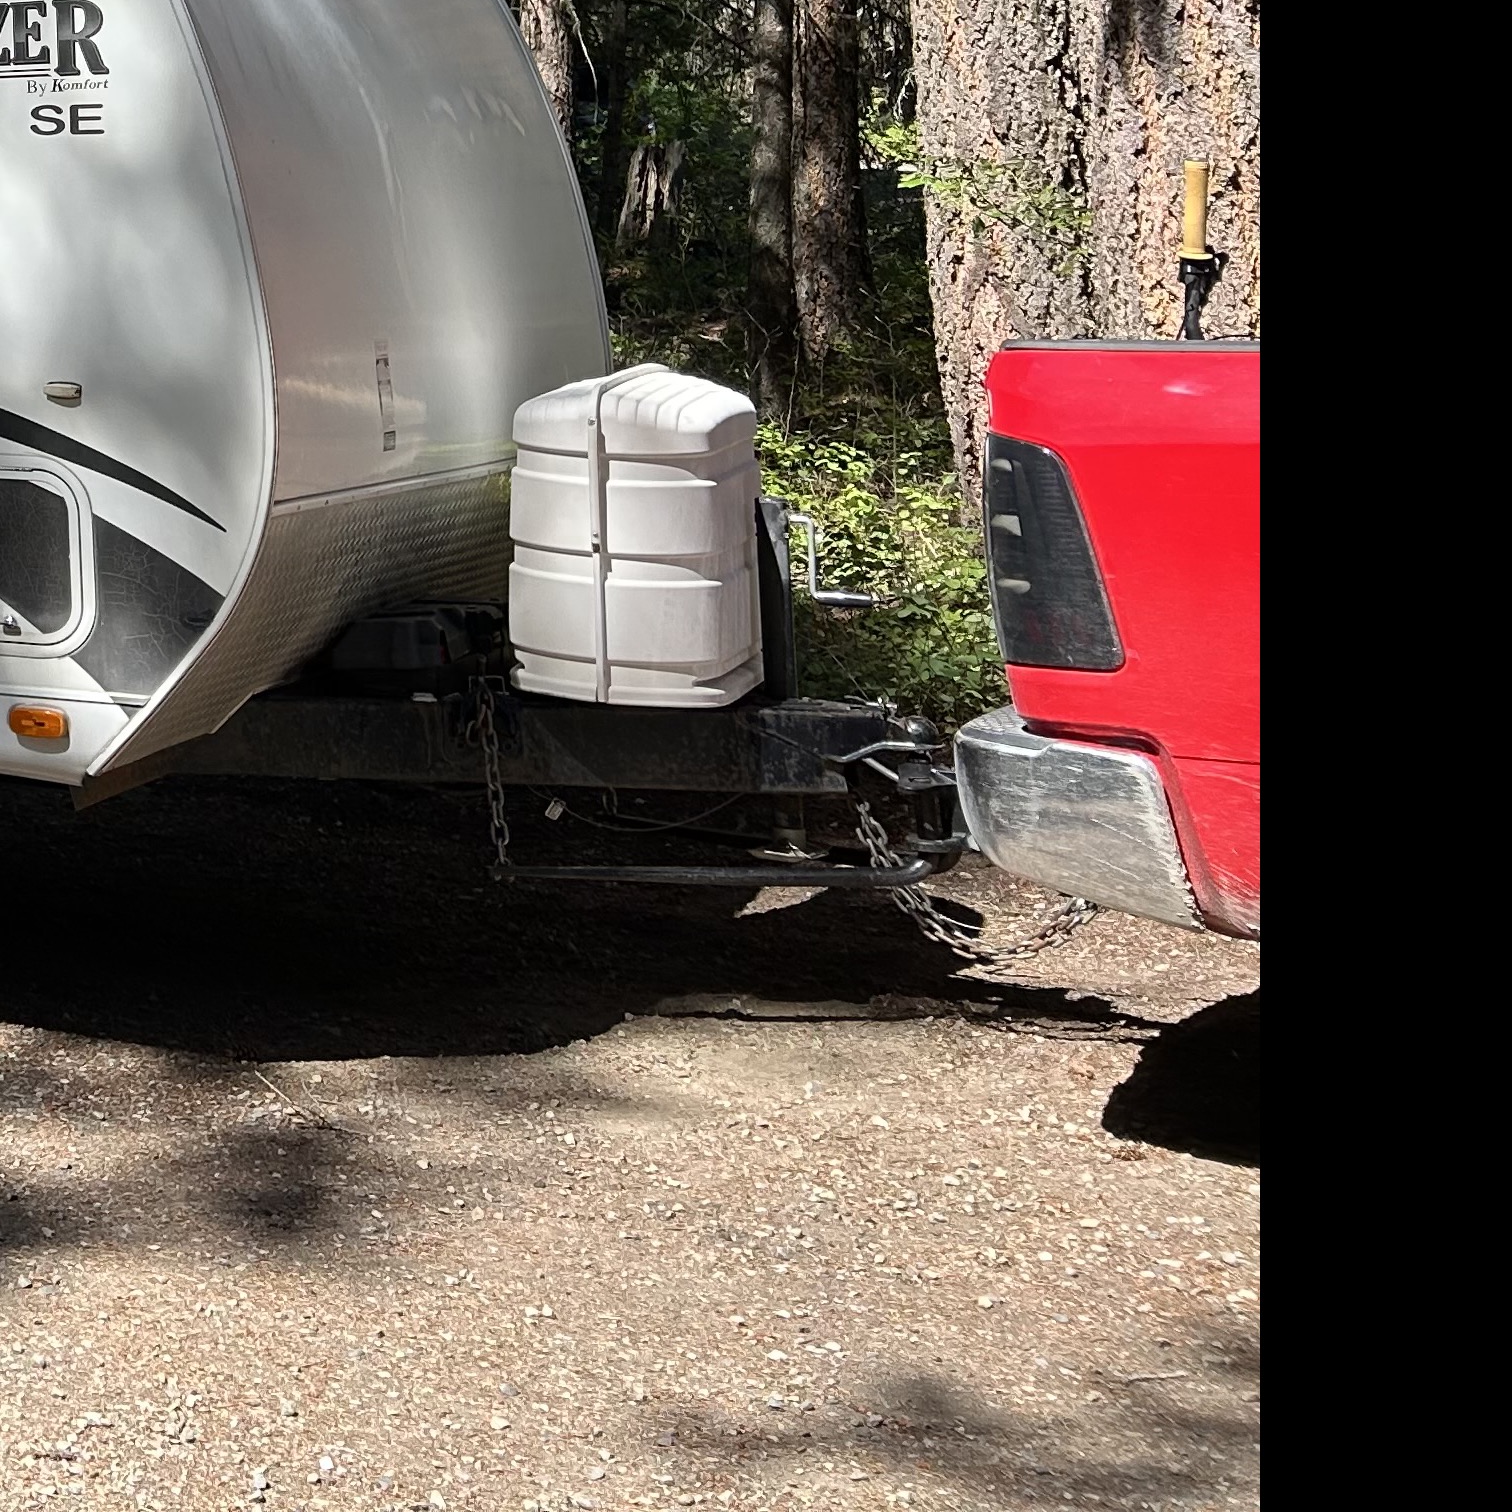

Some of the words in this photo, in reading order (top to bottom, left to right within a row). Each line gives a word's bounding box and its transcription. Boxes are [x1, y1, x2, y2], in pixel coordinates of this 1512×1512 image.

[26, 80, 47, 97] By
[51, 78, 109, 92] Komfort
[30, 103, 105, 135] SE
